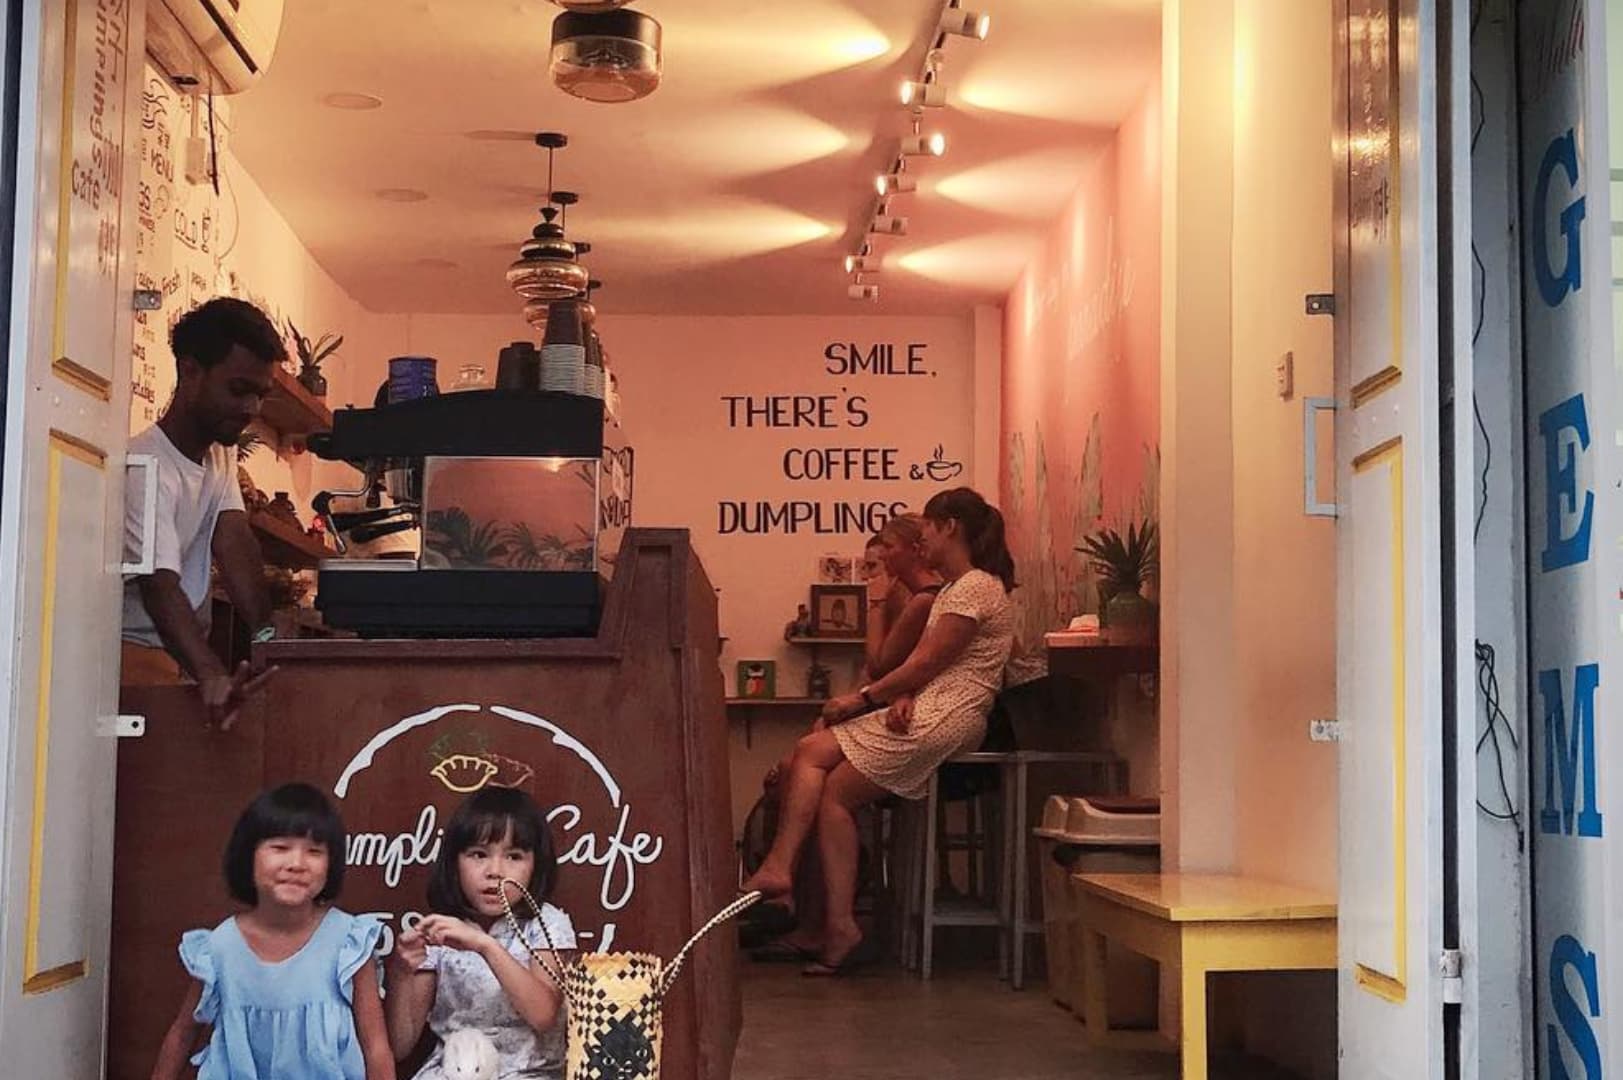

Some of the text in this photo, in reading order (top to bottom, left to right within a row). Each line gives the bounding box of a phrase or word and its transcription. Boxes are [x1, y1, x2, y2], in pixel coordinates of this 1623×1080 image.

[720, 386, 869, 428] THERE'S
[783, 447, 924, 480] COFFEE &
[1533, 127, 1603, 1080] GEMS
[545, 803, 663, 911] Cafe
